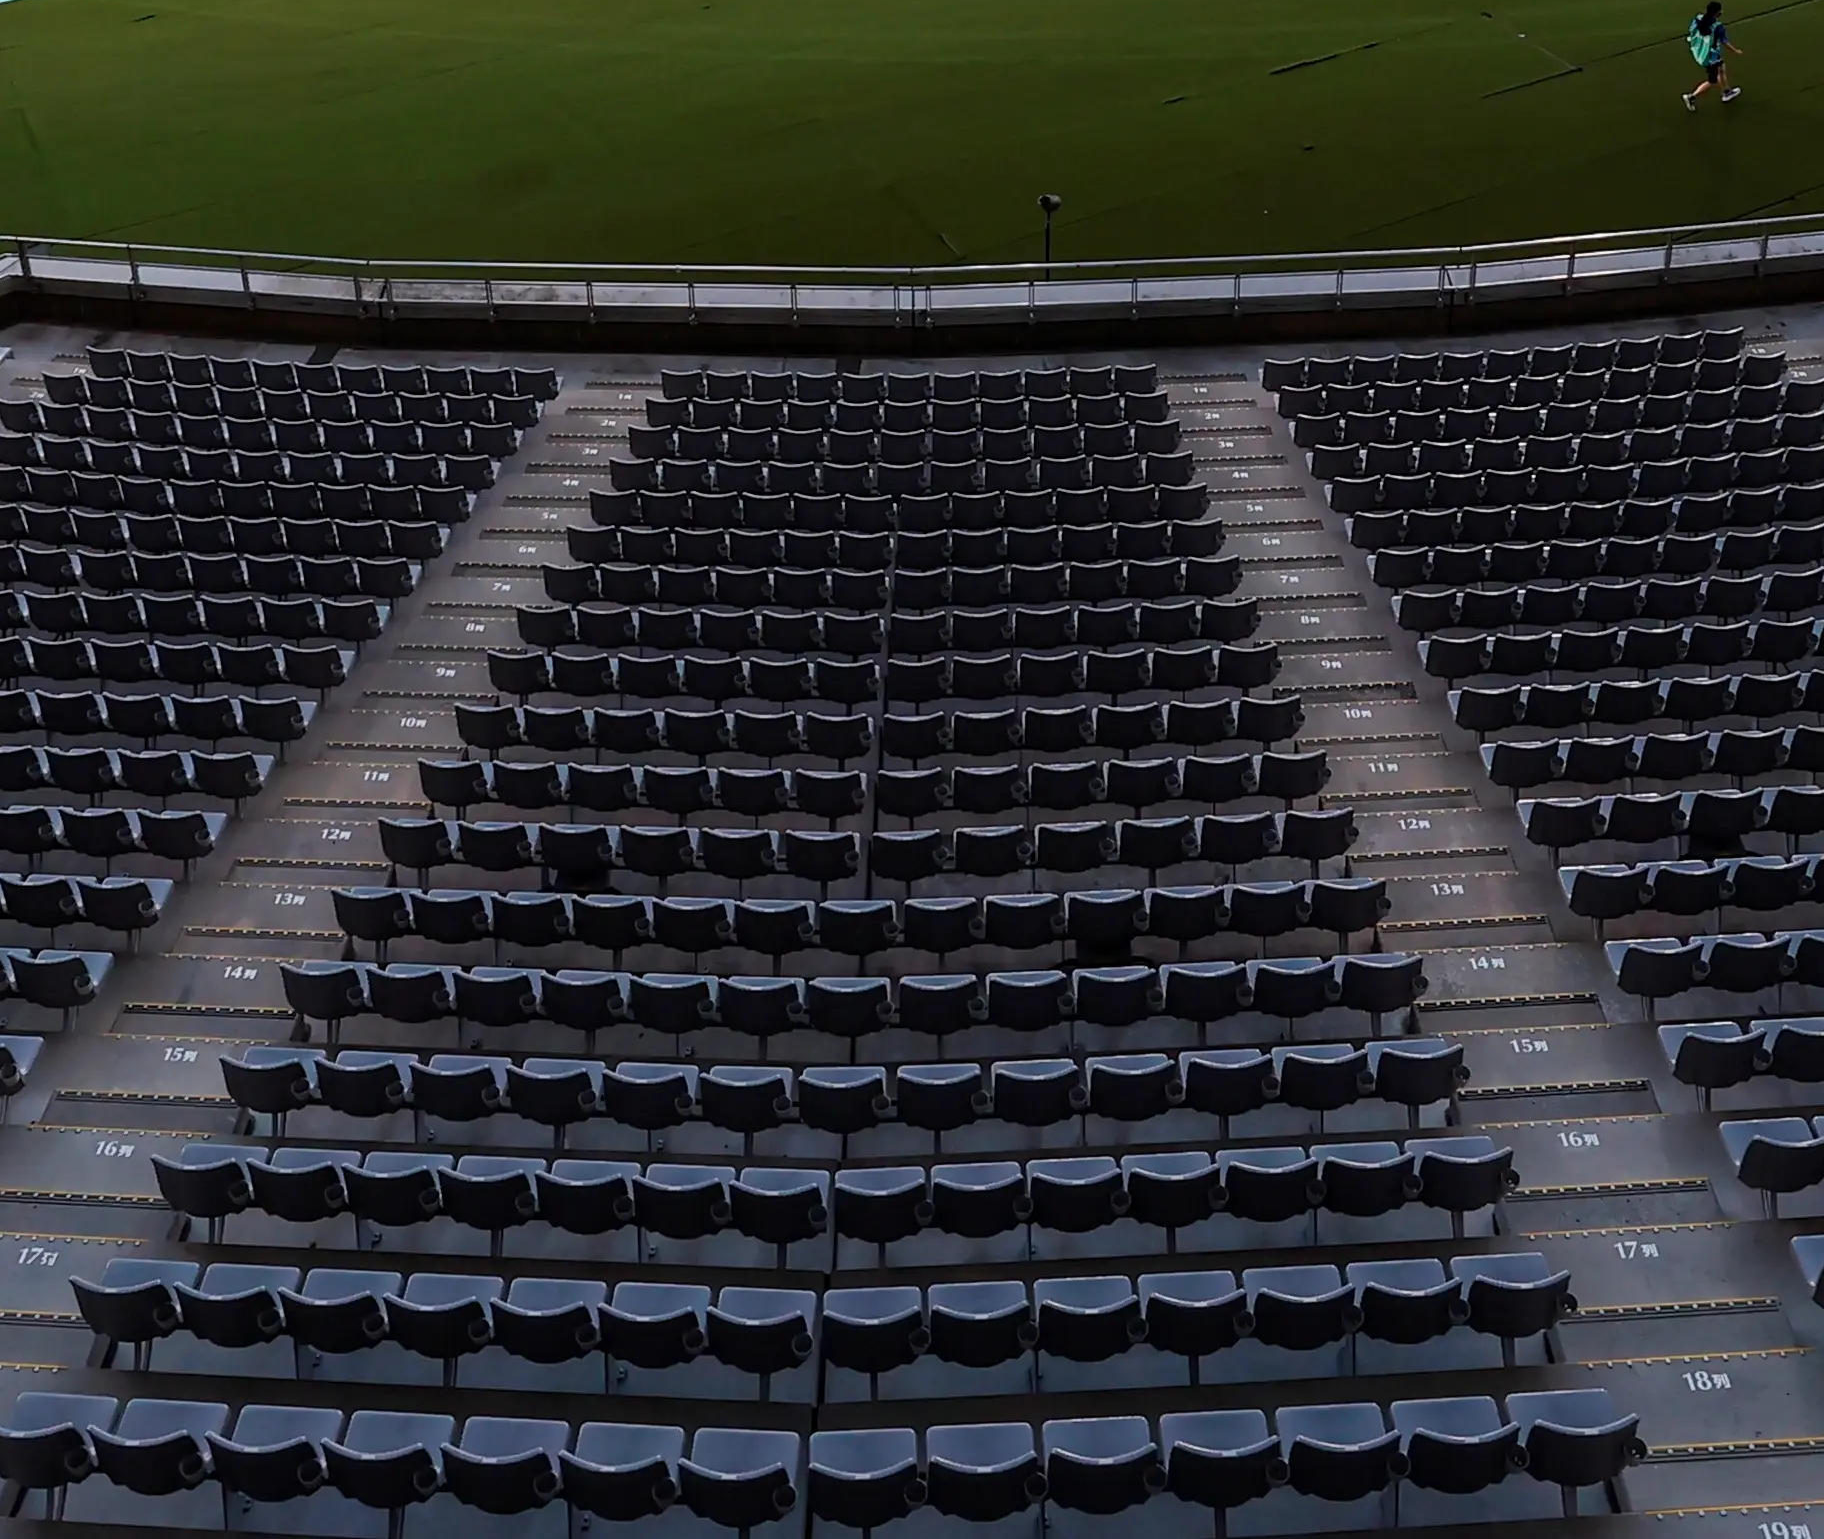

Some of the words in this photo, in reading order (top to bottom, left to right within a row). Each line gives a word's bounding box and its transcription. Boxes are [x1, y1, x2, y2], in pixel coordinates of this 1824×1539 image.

[1468, 956, 1506, 970] 14列
[223, 965, 258, 980] 14列
[1509, 1038, 1549, 1053] 15列
[164, 1047, 198, 1063] 15列
[1556, 1131, 1600, 1147] 16列
[95, 1140, 135, 1158] 16列
[18, 1247, 59, 1267] 17列
[1613, 1240, 1659, 1259] 17列
[1682, 1371, 1732, 1391] 18列
[1757, 1521, 1812, 1539] 19列
